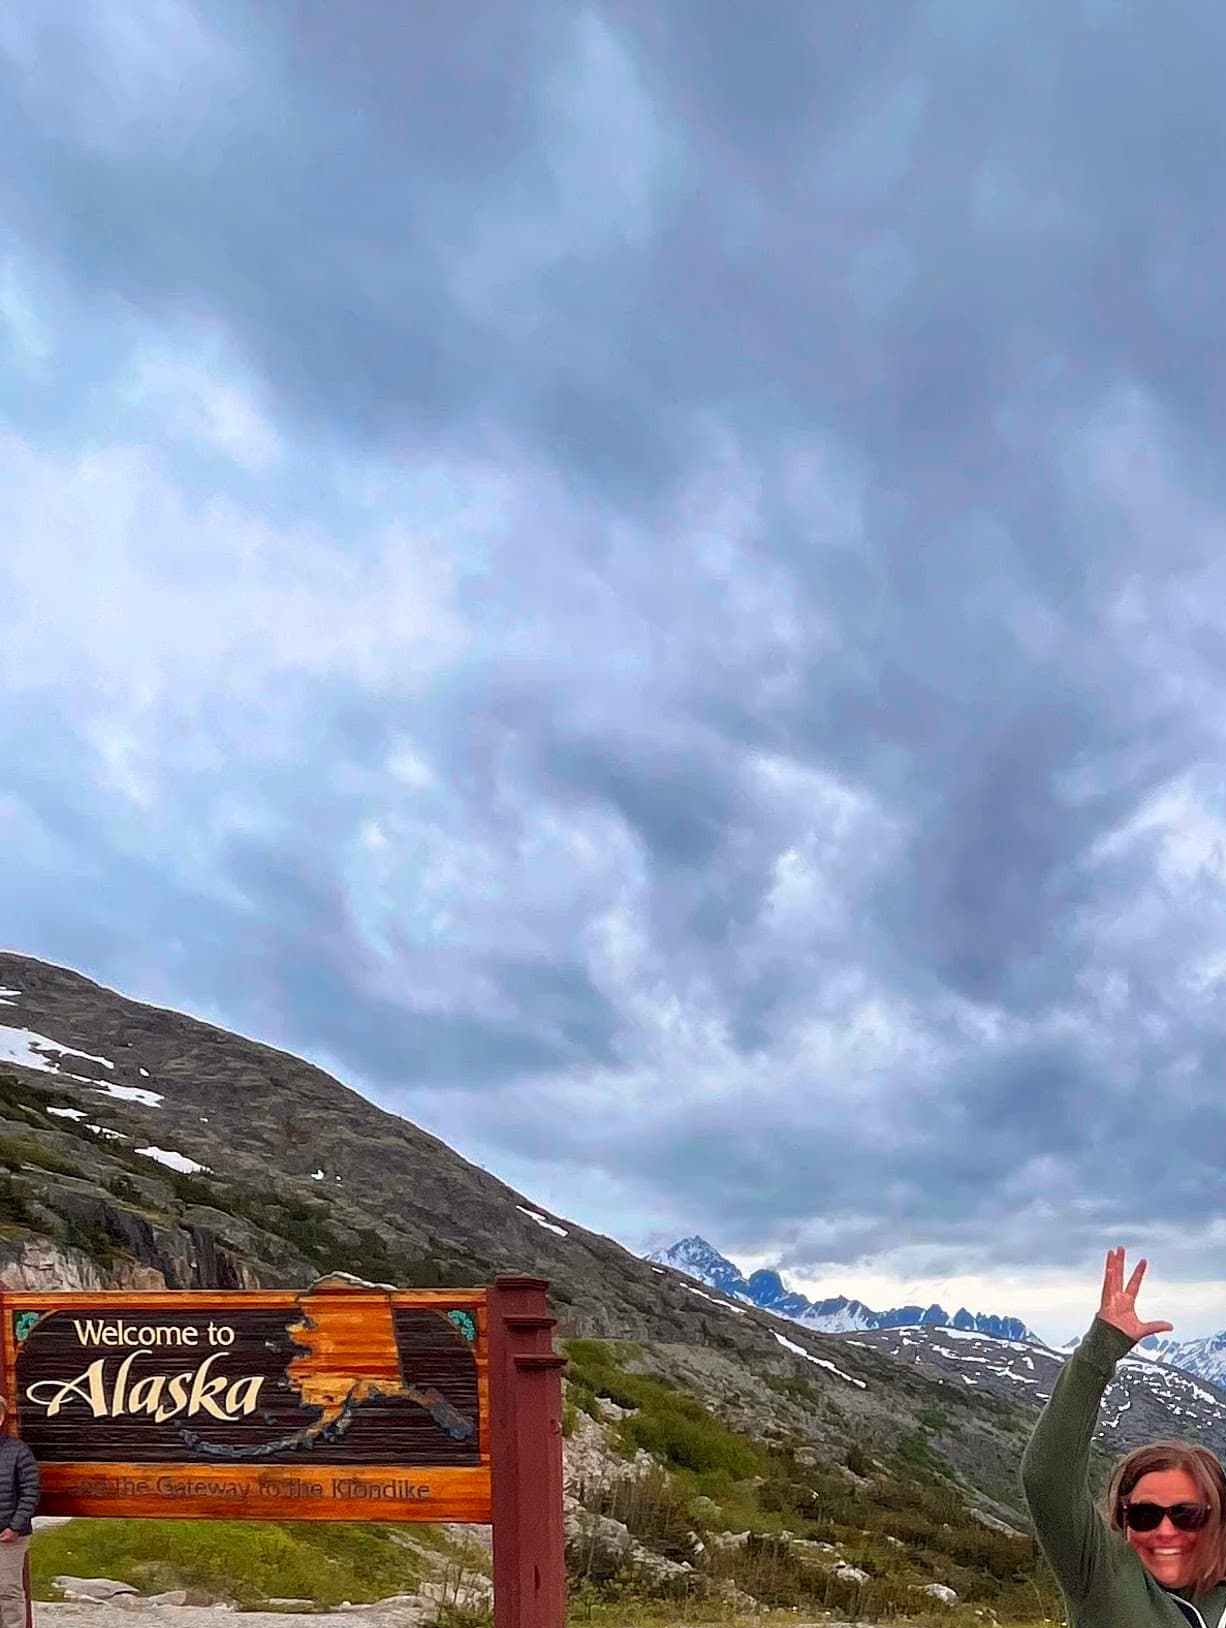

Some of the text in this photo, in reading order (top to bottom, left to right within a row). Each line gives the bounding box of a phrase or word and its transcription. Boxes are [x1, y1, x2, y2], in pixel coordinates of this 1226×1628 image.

[74, 1319, 235, 1346] Welcome to
[26, 1349, 265, 1423] Alaska
[156, 1476, 250, 1499] Gateway
[259, 1477, 280, 1498] to
[332, 1477, 431, 1499] Klondike
